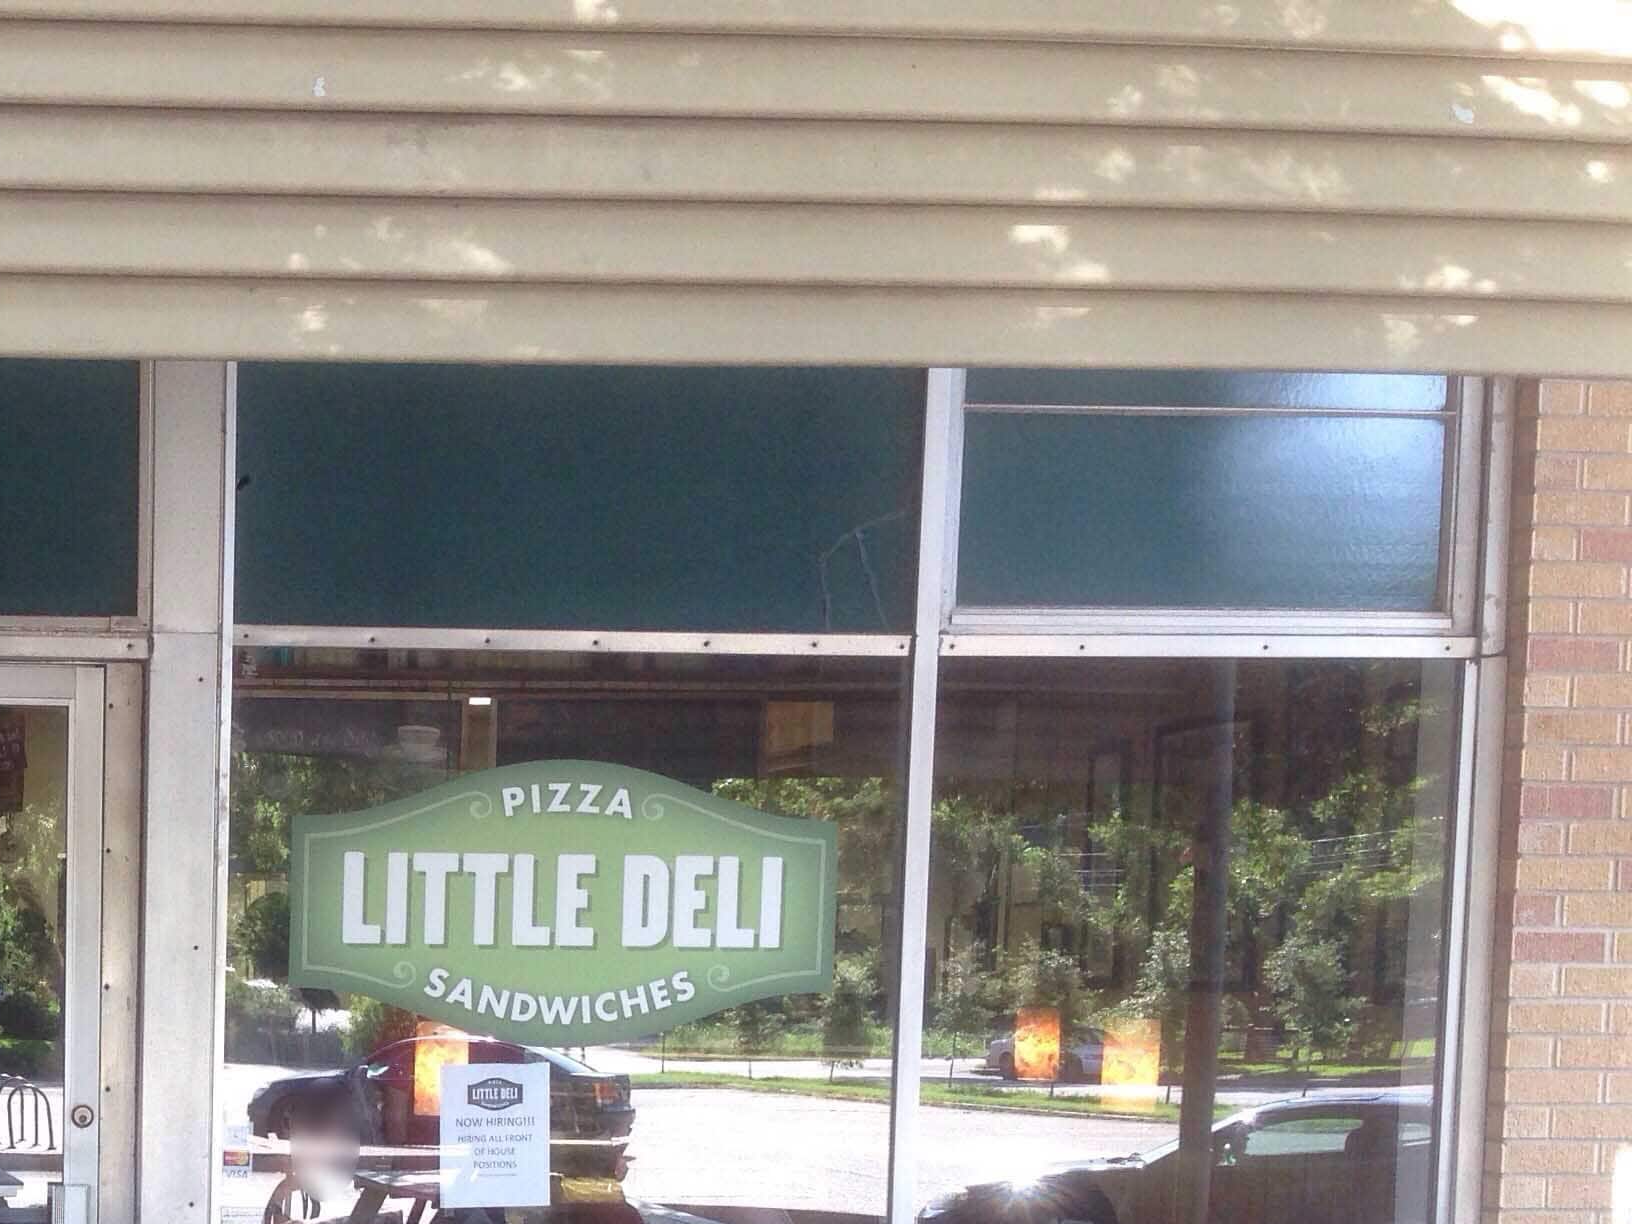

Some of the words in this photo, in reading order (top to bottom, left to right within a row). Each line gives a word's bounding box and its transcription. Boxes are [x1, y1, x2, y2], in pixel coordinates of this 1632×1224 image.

[501, 782, 634, 820] PIZZA
[342, 850, 597, 947] LITTLE
[620, 853, 784, 949] DELI
[423, 967, 696, 1026] SANDWICHES
[472, 1088, 499, 1100] LITTLE
[500, 1087, 518, 1100] DELI
[455, 1117, 483, 1128] NOW
[473, 1160, 518, 1169] POSITIONS
